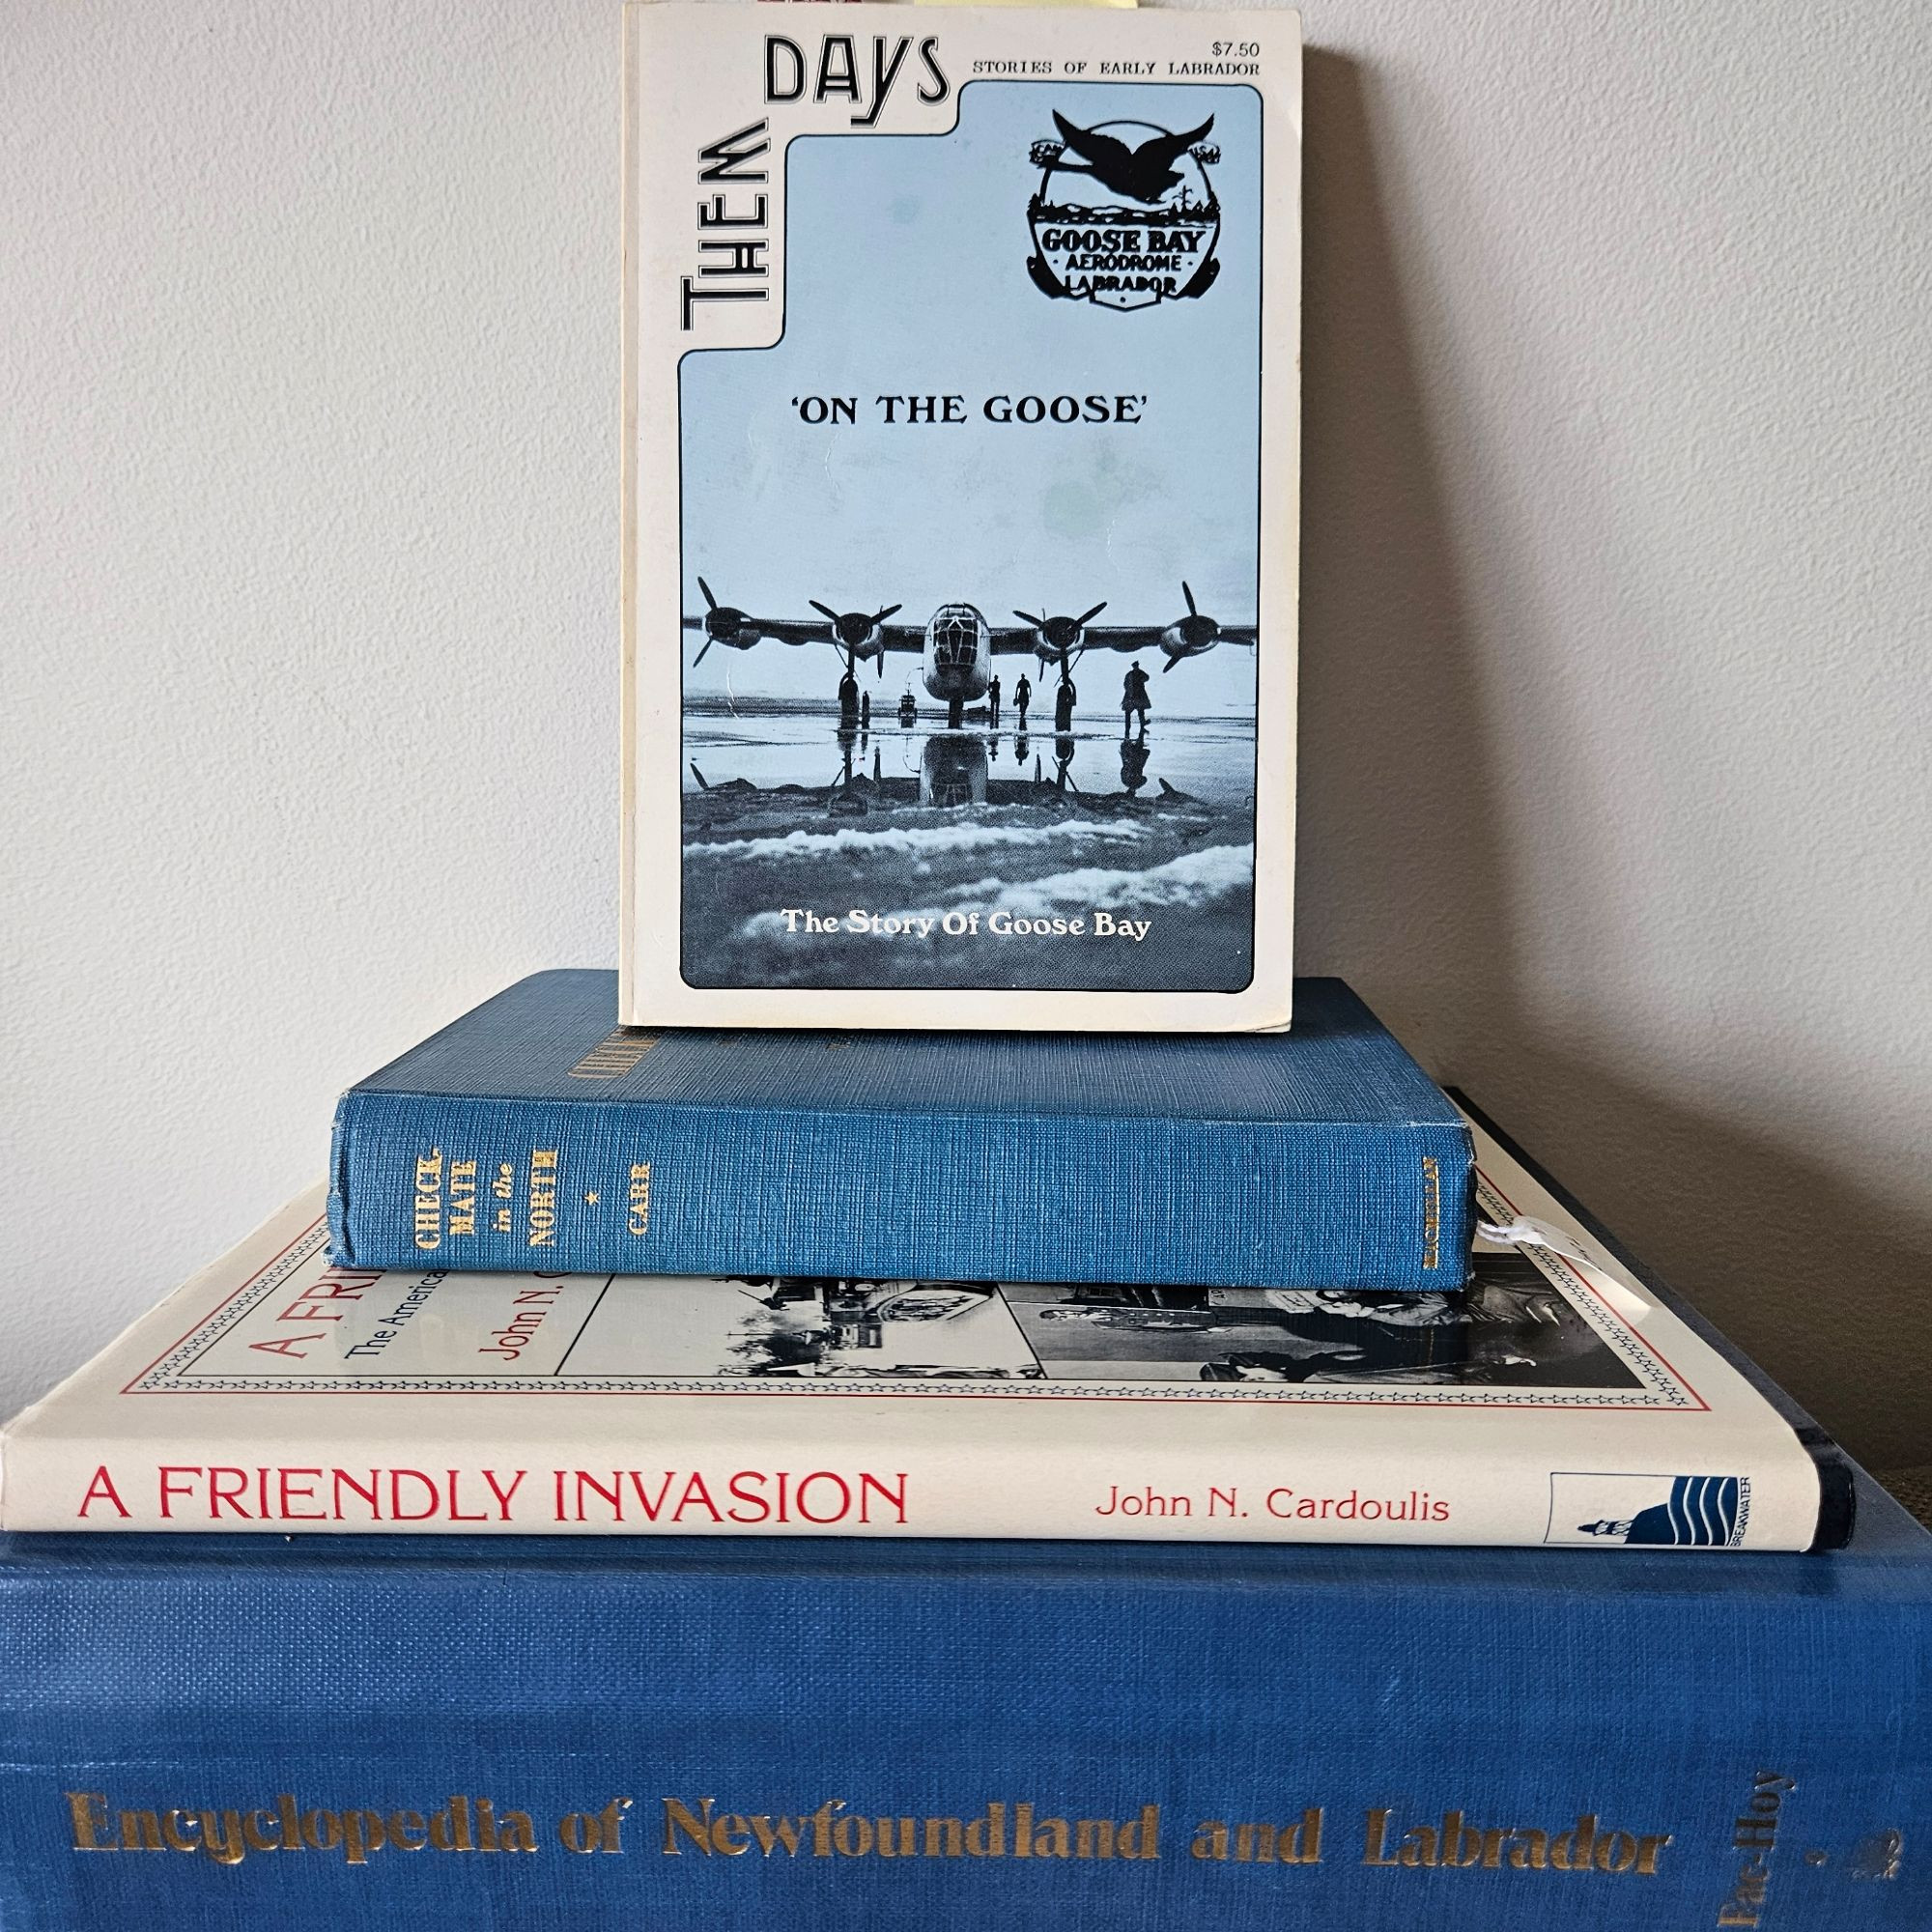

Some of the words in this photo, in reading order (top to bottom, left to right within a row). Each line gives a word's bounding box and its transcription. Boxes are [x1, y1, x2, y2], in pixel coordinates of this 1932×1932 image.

[1212, 42, 1260, 58] $7.50
[973, 60, 1052, 75] STORIES
[1065, 62, 1087, 75] OF
[1100, 62, 1155, 76] EARLY
[1168, 62, 1260, 77] LABRADOR
[681, 117, 771, 330] THEM
[1041, 229, 1141, 253] GOOSE
[1147, 230, 1206, 253] BAY
[1065, 254, 1181, 271] AERODROME
[1064, 275, 1177, 293] LABRADOR
[875, 395, 967, 424] THE
[779, 908, 839, 934] The
[847, 909, 935, 939] Story
[942, 912, 980, 936] Of
[988, 912, 1087, 936] Goose
[1094, 912, 1152, 942] Bay
[492, 1162, 513, 1199] the
[449, 1160, 477, 1236] MATE
[530, 1149, 558, 1247] NORTH
[629, 1161, 651, 1236] CARR
[493, 1208, 512, 1233] in
[276, 1267, 388, 1322] FRI
[512, 1285, 565, 1306] N.
[248, 1332, 327, 1359] A
[343, 1328, 397, 1360] The
[479, 1311, 548, 1361] John
[77, 1465, 133, 1518] A
[157, 1466, 528, 1522] FRIENDLY
[554, 1470, 908, 1523] INVASION
[1095, 1486, 1193, 1517] John
[1208, 1487, 1249, 1518] N.
[1266, 1488, 1451, 1521] Cardoulis
[1730, 1476, 1751, 1547] BREAKWATER
[66, 1791, 539, 1864] Encyclopedia
[559, 1798, 634, 1854] of
[662, 1797, 1161, 1860] Newfoundland
[1191, 1807, 1322, 1863] and
[1363, 1808, 1673, 1874] Labrador
